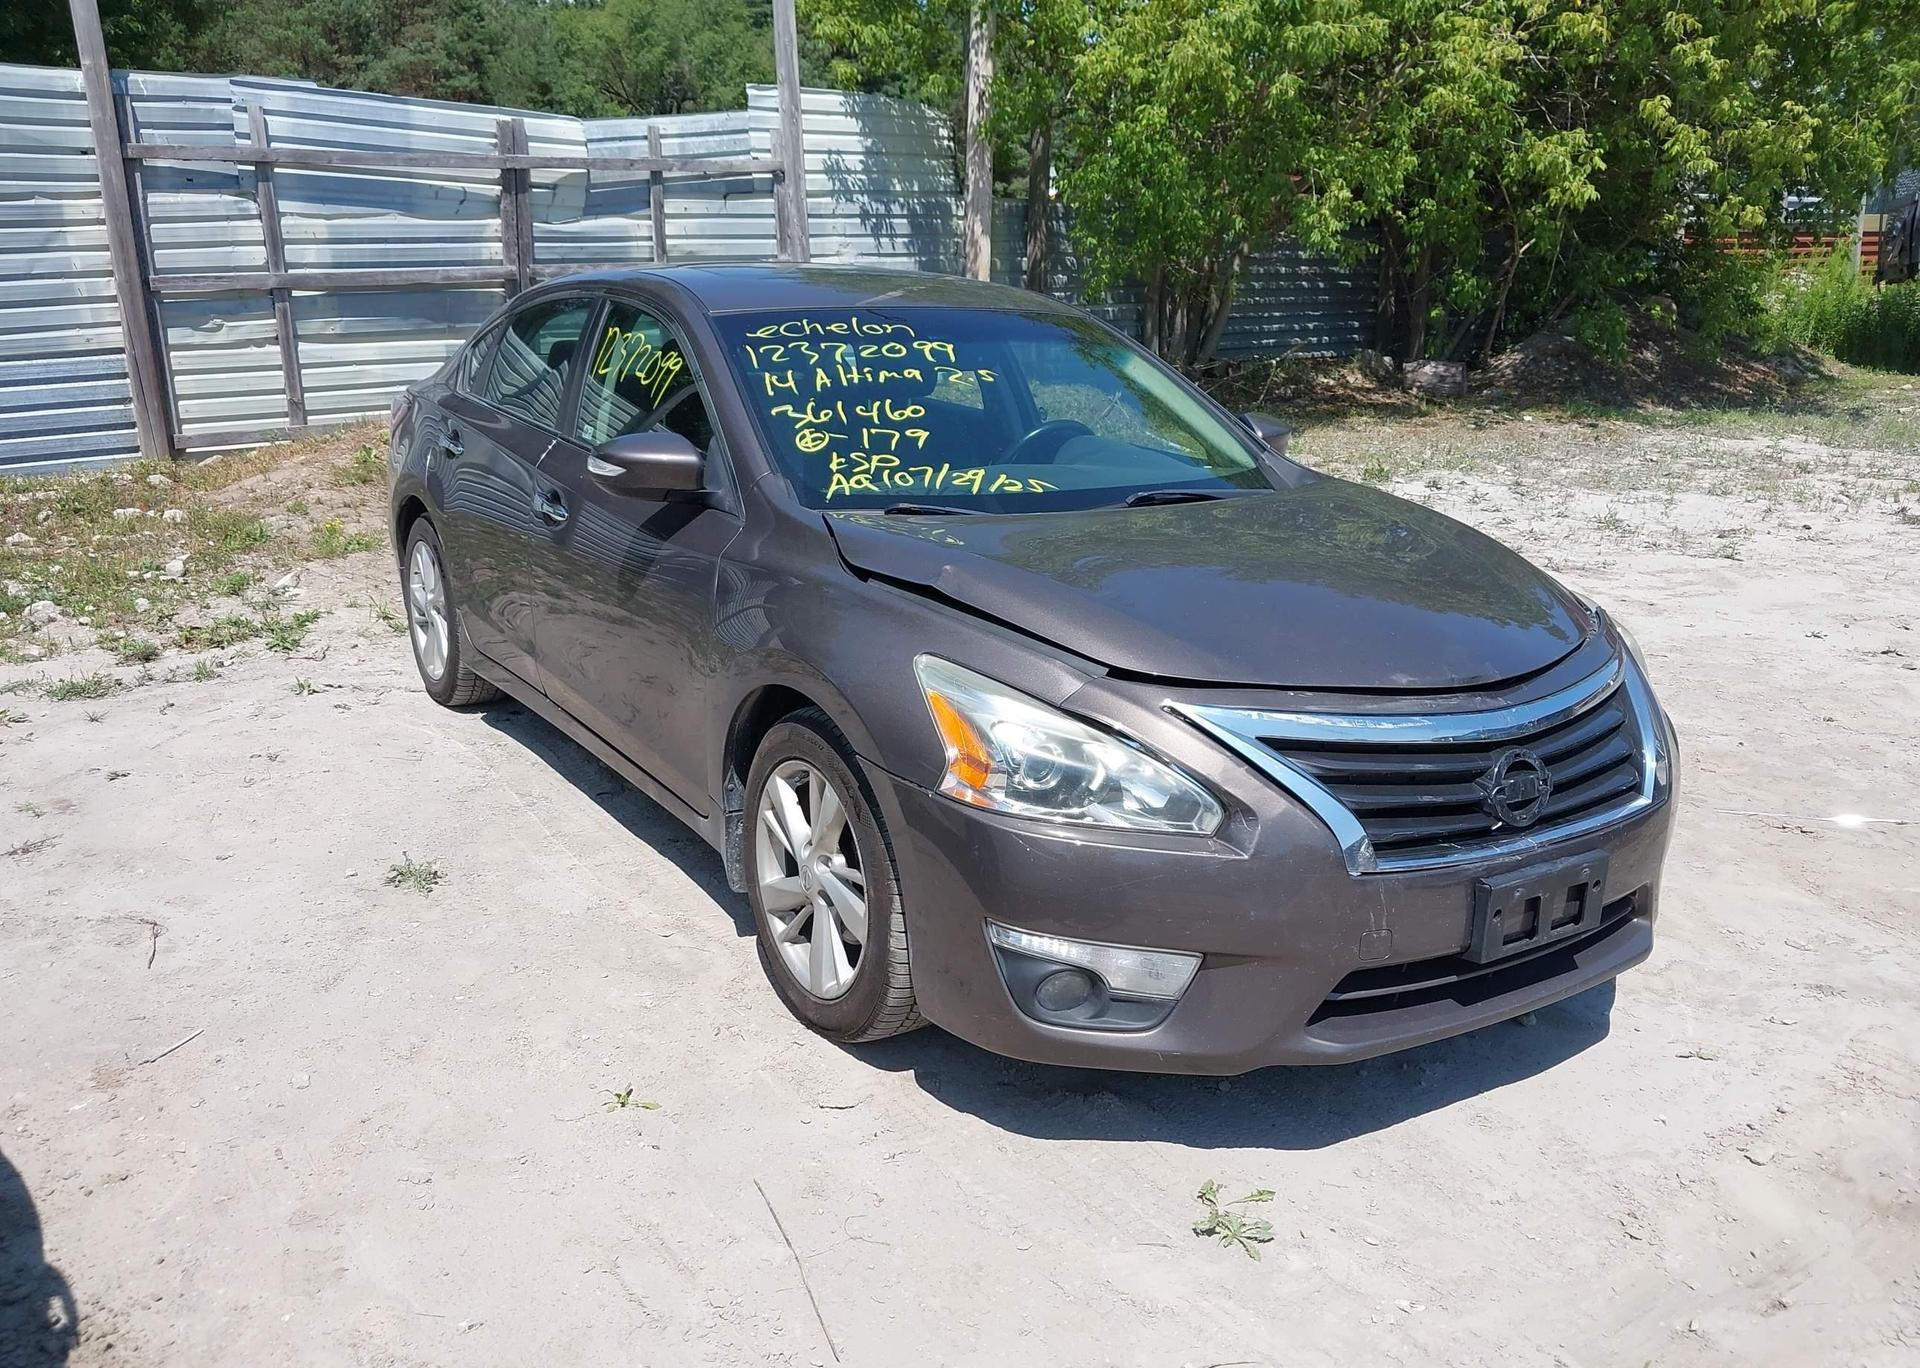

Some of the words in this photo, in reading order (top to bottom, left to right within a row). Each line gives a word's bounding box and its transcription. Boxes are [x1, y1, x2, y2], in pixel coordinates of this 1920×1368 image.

[592, 326, 682, 410] 12372099
[745, 341, 954, 369] 12372099
[765, 369, 799, 396] 14
[815, 363, 923, 392] Altima
[862, 427, 930, 451] 179
